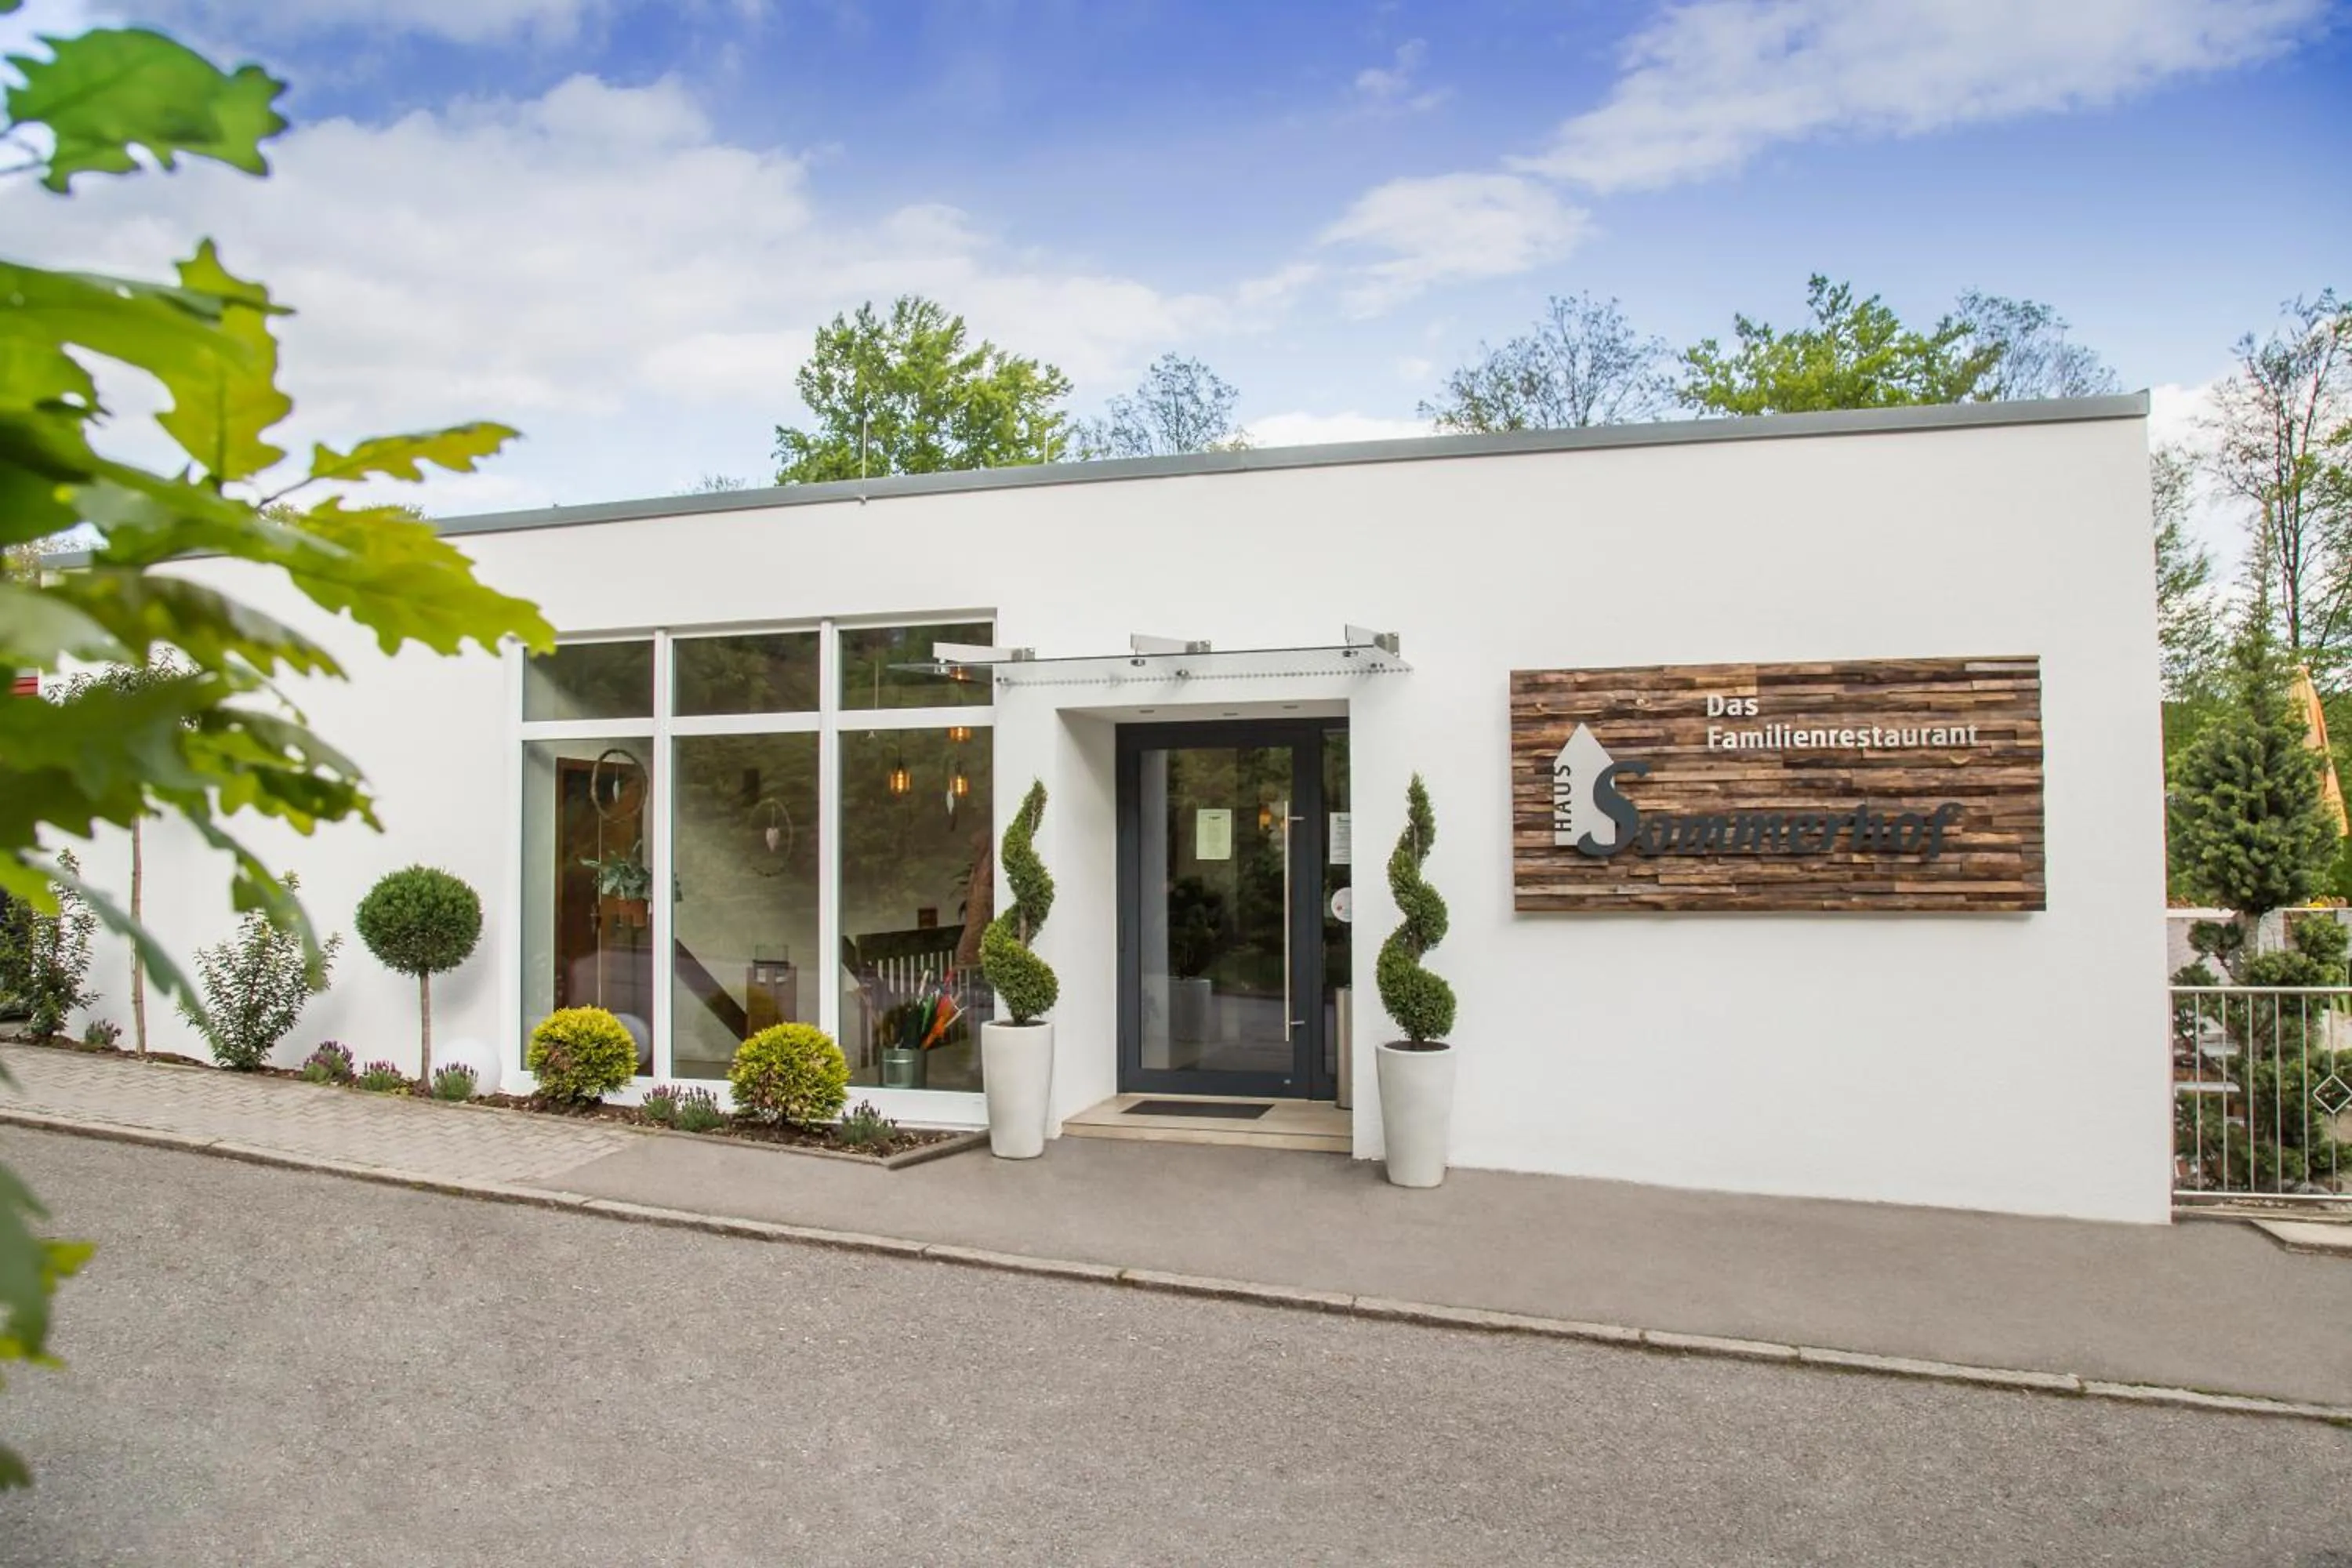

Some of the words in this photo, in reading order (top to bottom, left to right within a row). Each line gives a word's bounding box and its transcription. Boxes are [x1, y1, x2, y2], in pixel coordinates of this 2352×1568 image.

[1707, 694, 1759, 717] Das
[1707, 724, 1979, 750] Familienrestaurant
[1555, 764, 1572, 833] HAUS
[1577, 761, 1962, 858] Sommerhof
